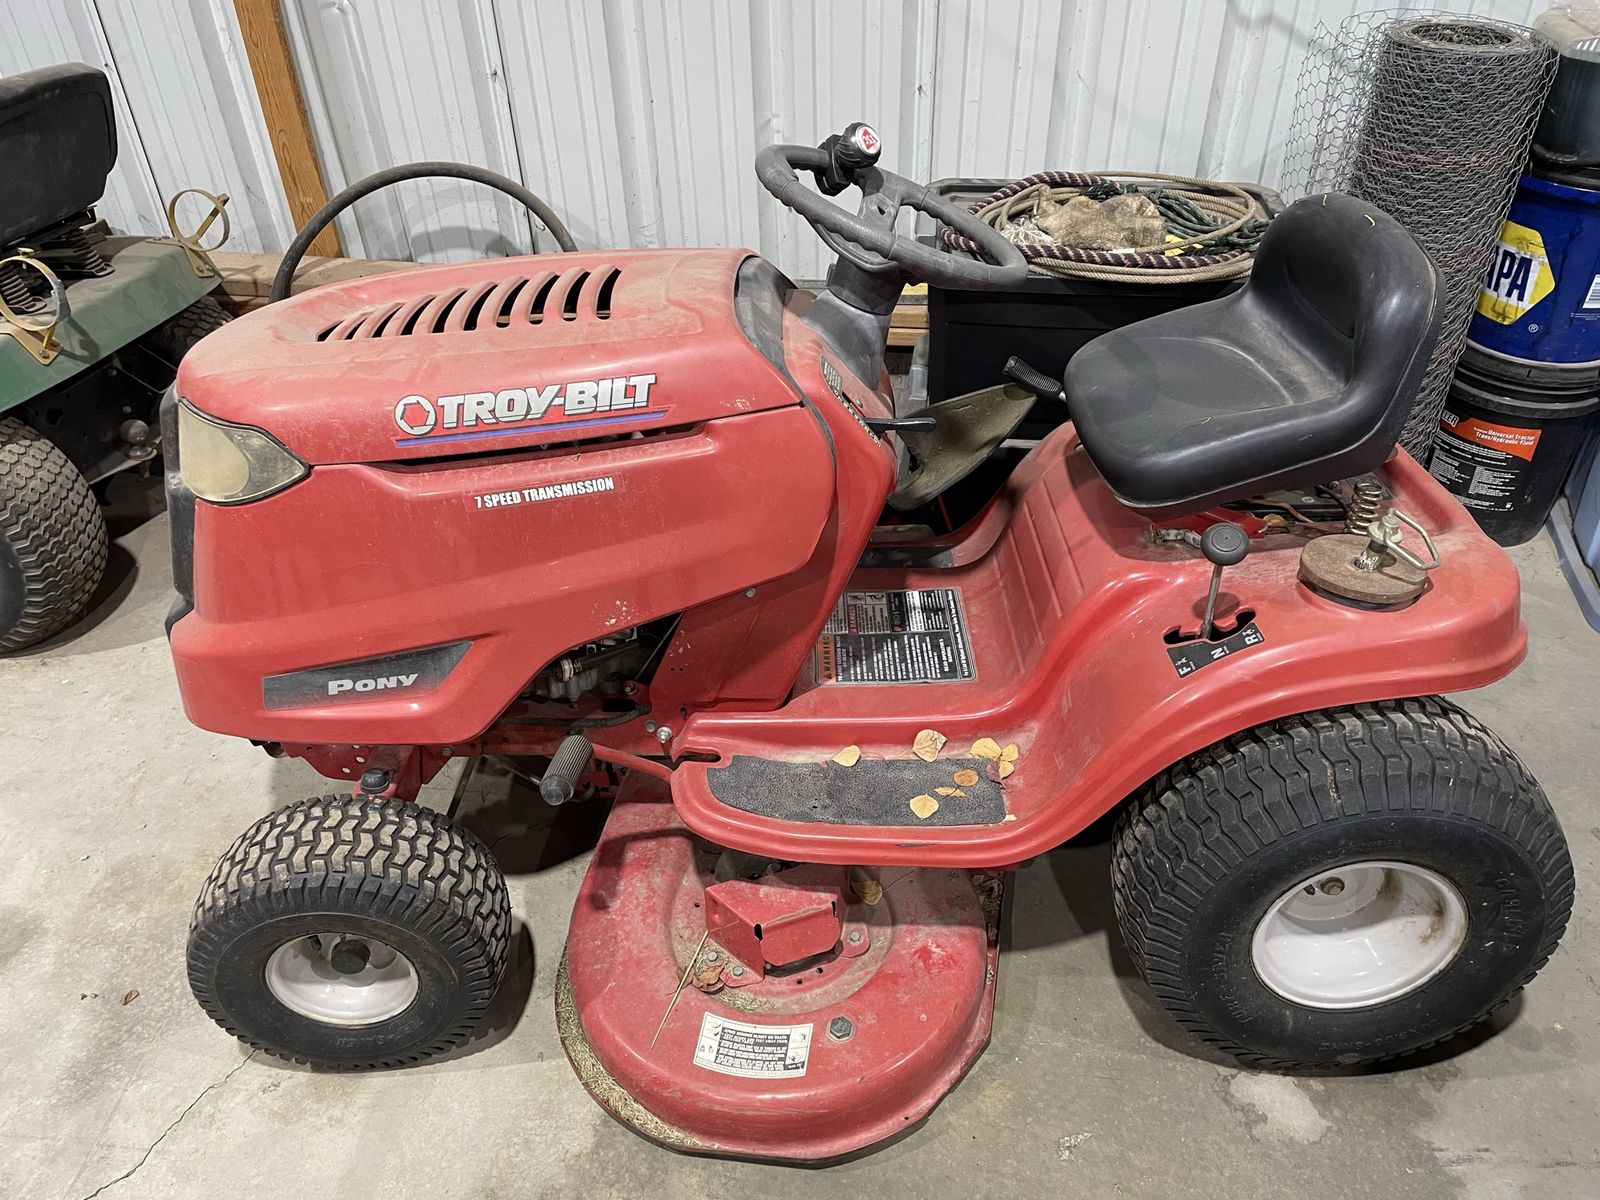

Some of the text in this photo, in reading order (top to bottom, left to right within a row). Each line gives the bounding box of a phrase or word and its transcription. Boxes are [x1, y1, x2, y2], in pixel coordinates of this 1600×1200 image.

[438, 374, 656, 429] TROY-BILT
[1488, 429, 1515, 439] Universal
[474, 476, 615, 509] 7 SPEED TRANSMISSION
[1244, 634, 1259, 645] R
[823, 636, 831, 672] WARNING
[1210, 647, 1226, 659] N
[1178, 666, 1192, 675] F
